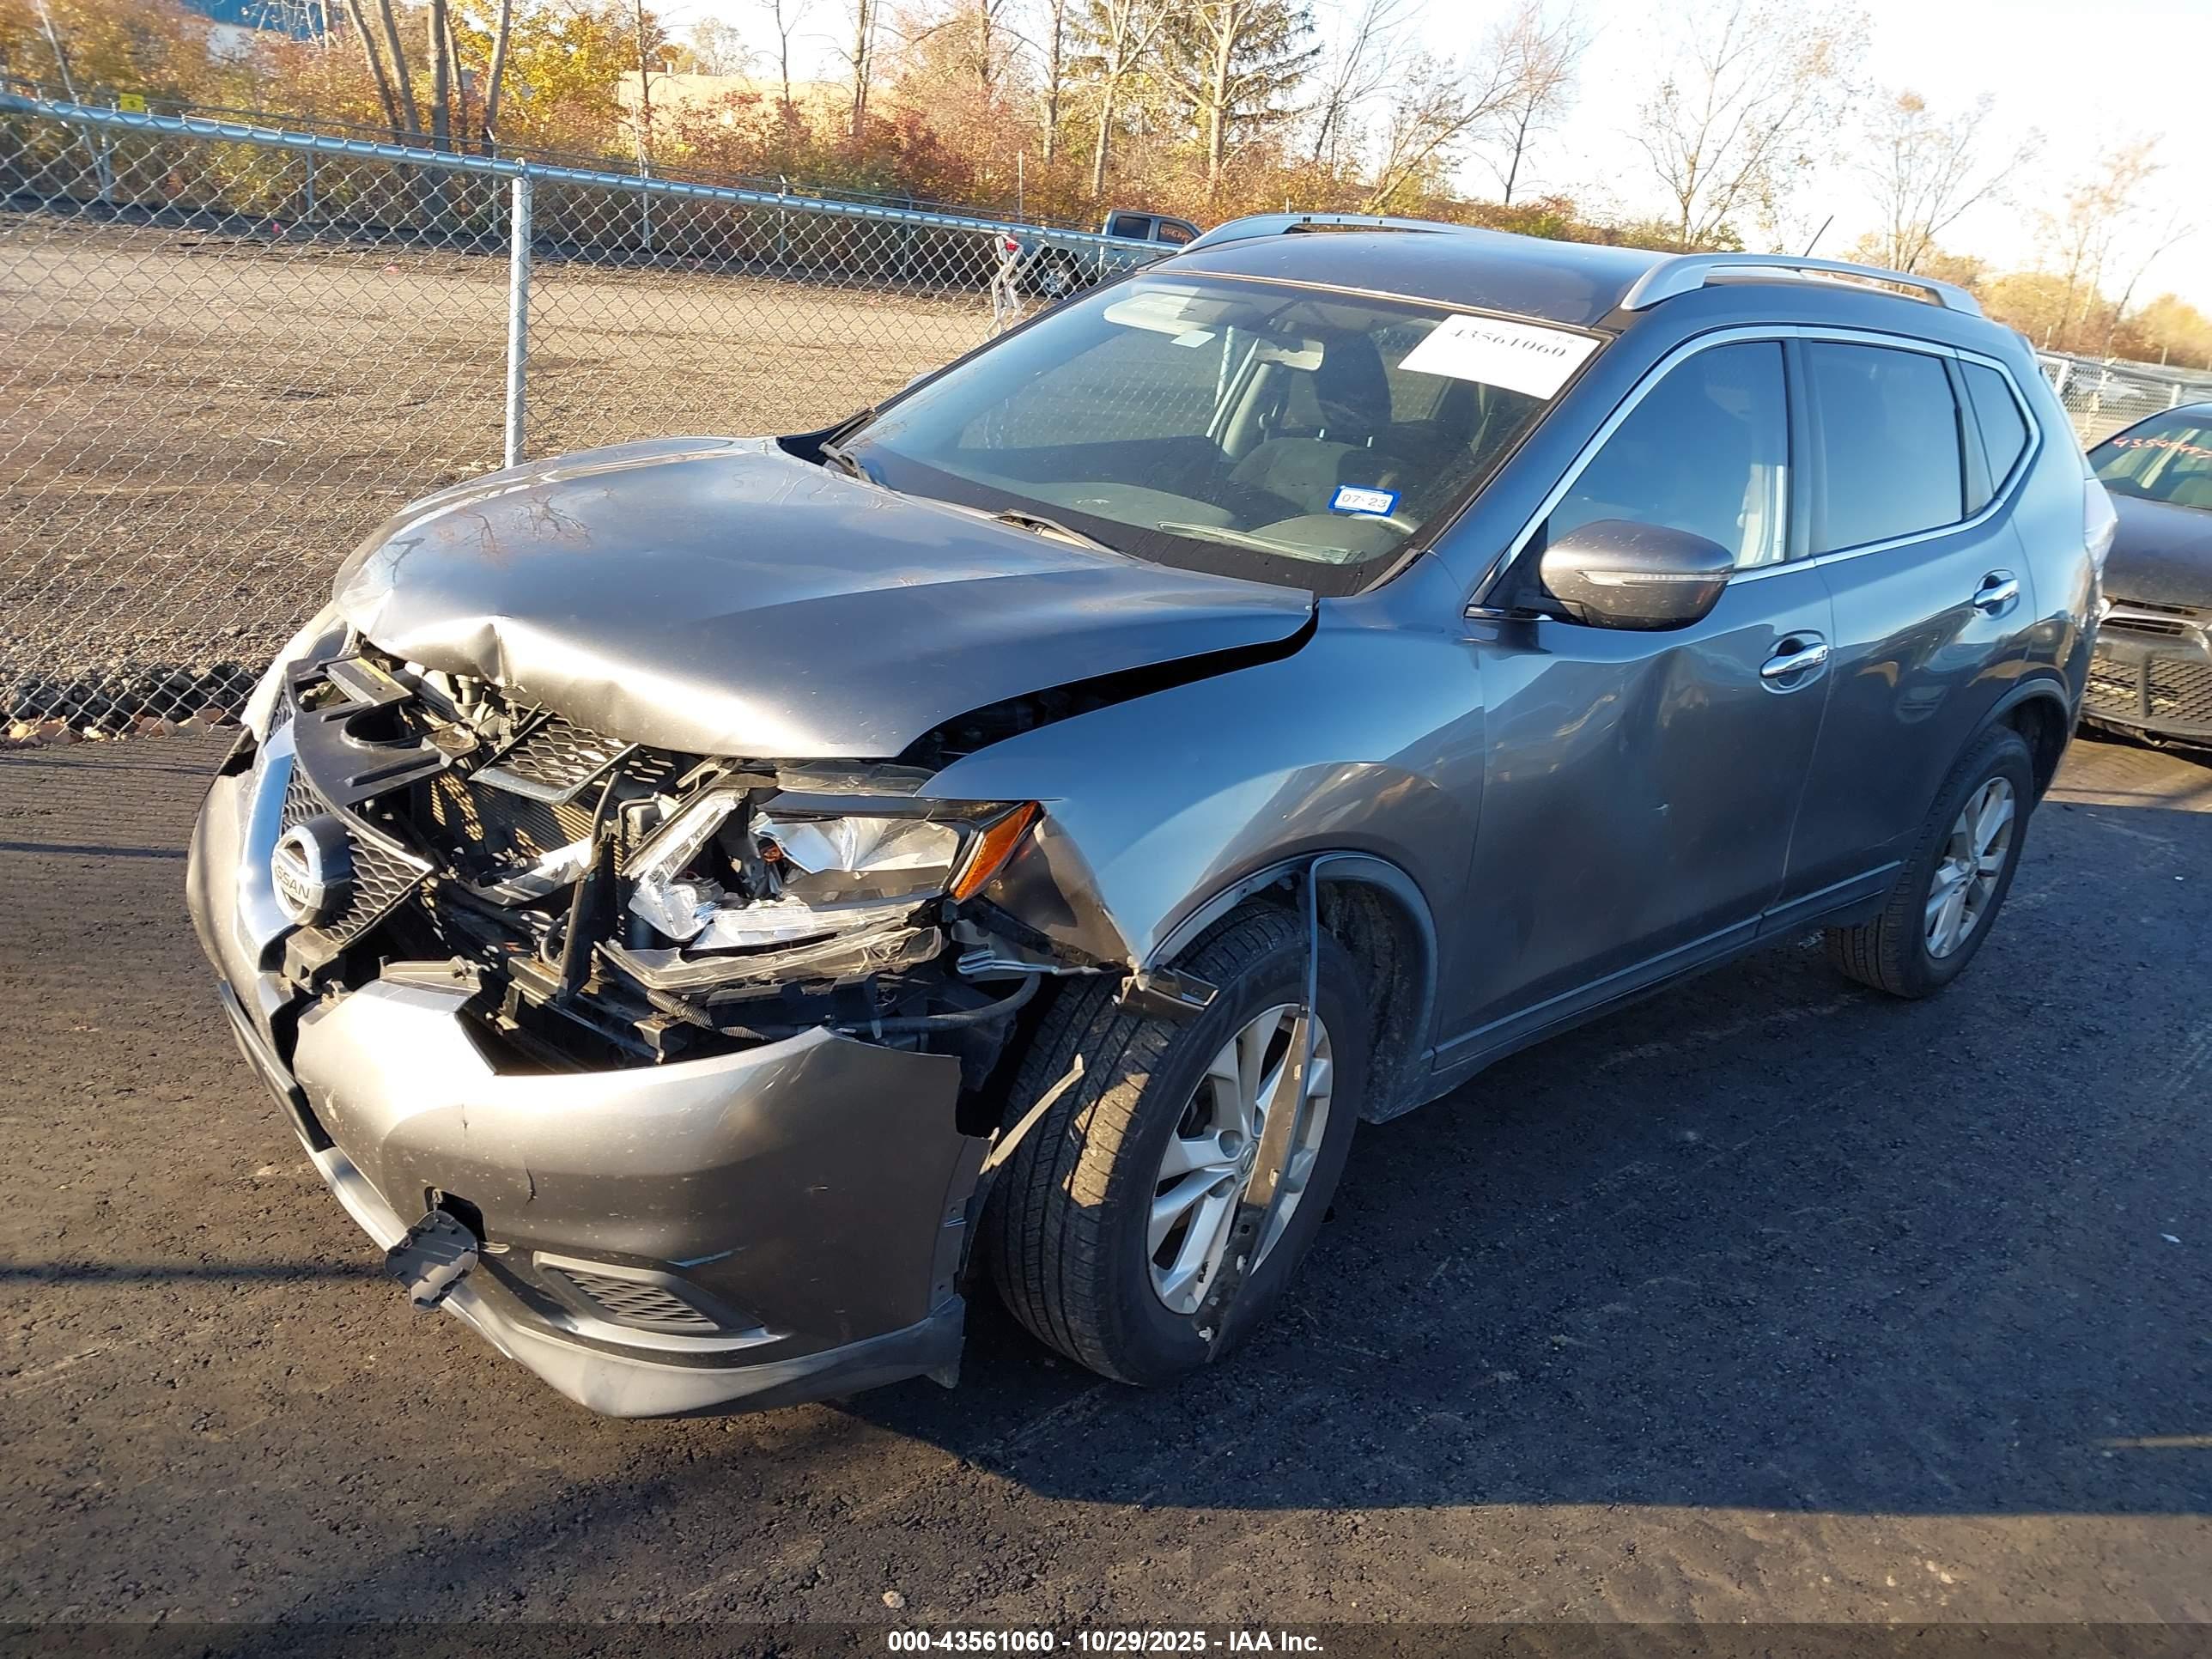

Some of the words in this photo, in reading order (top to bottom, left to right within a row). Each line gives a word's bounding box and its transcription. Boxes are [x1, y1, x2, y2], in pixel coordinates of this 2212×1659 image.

[1449, 329, 1567, 357] 43561060
[1341, 494, 1361, 503] 07
[1368, 497, 1388, 508] 23
[273, 861, 311, 899] ISSAN
